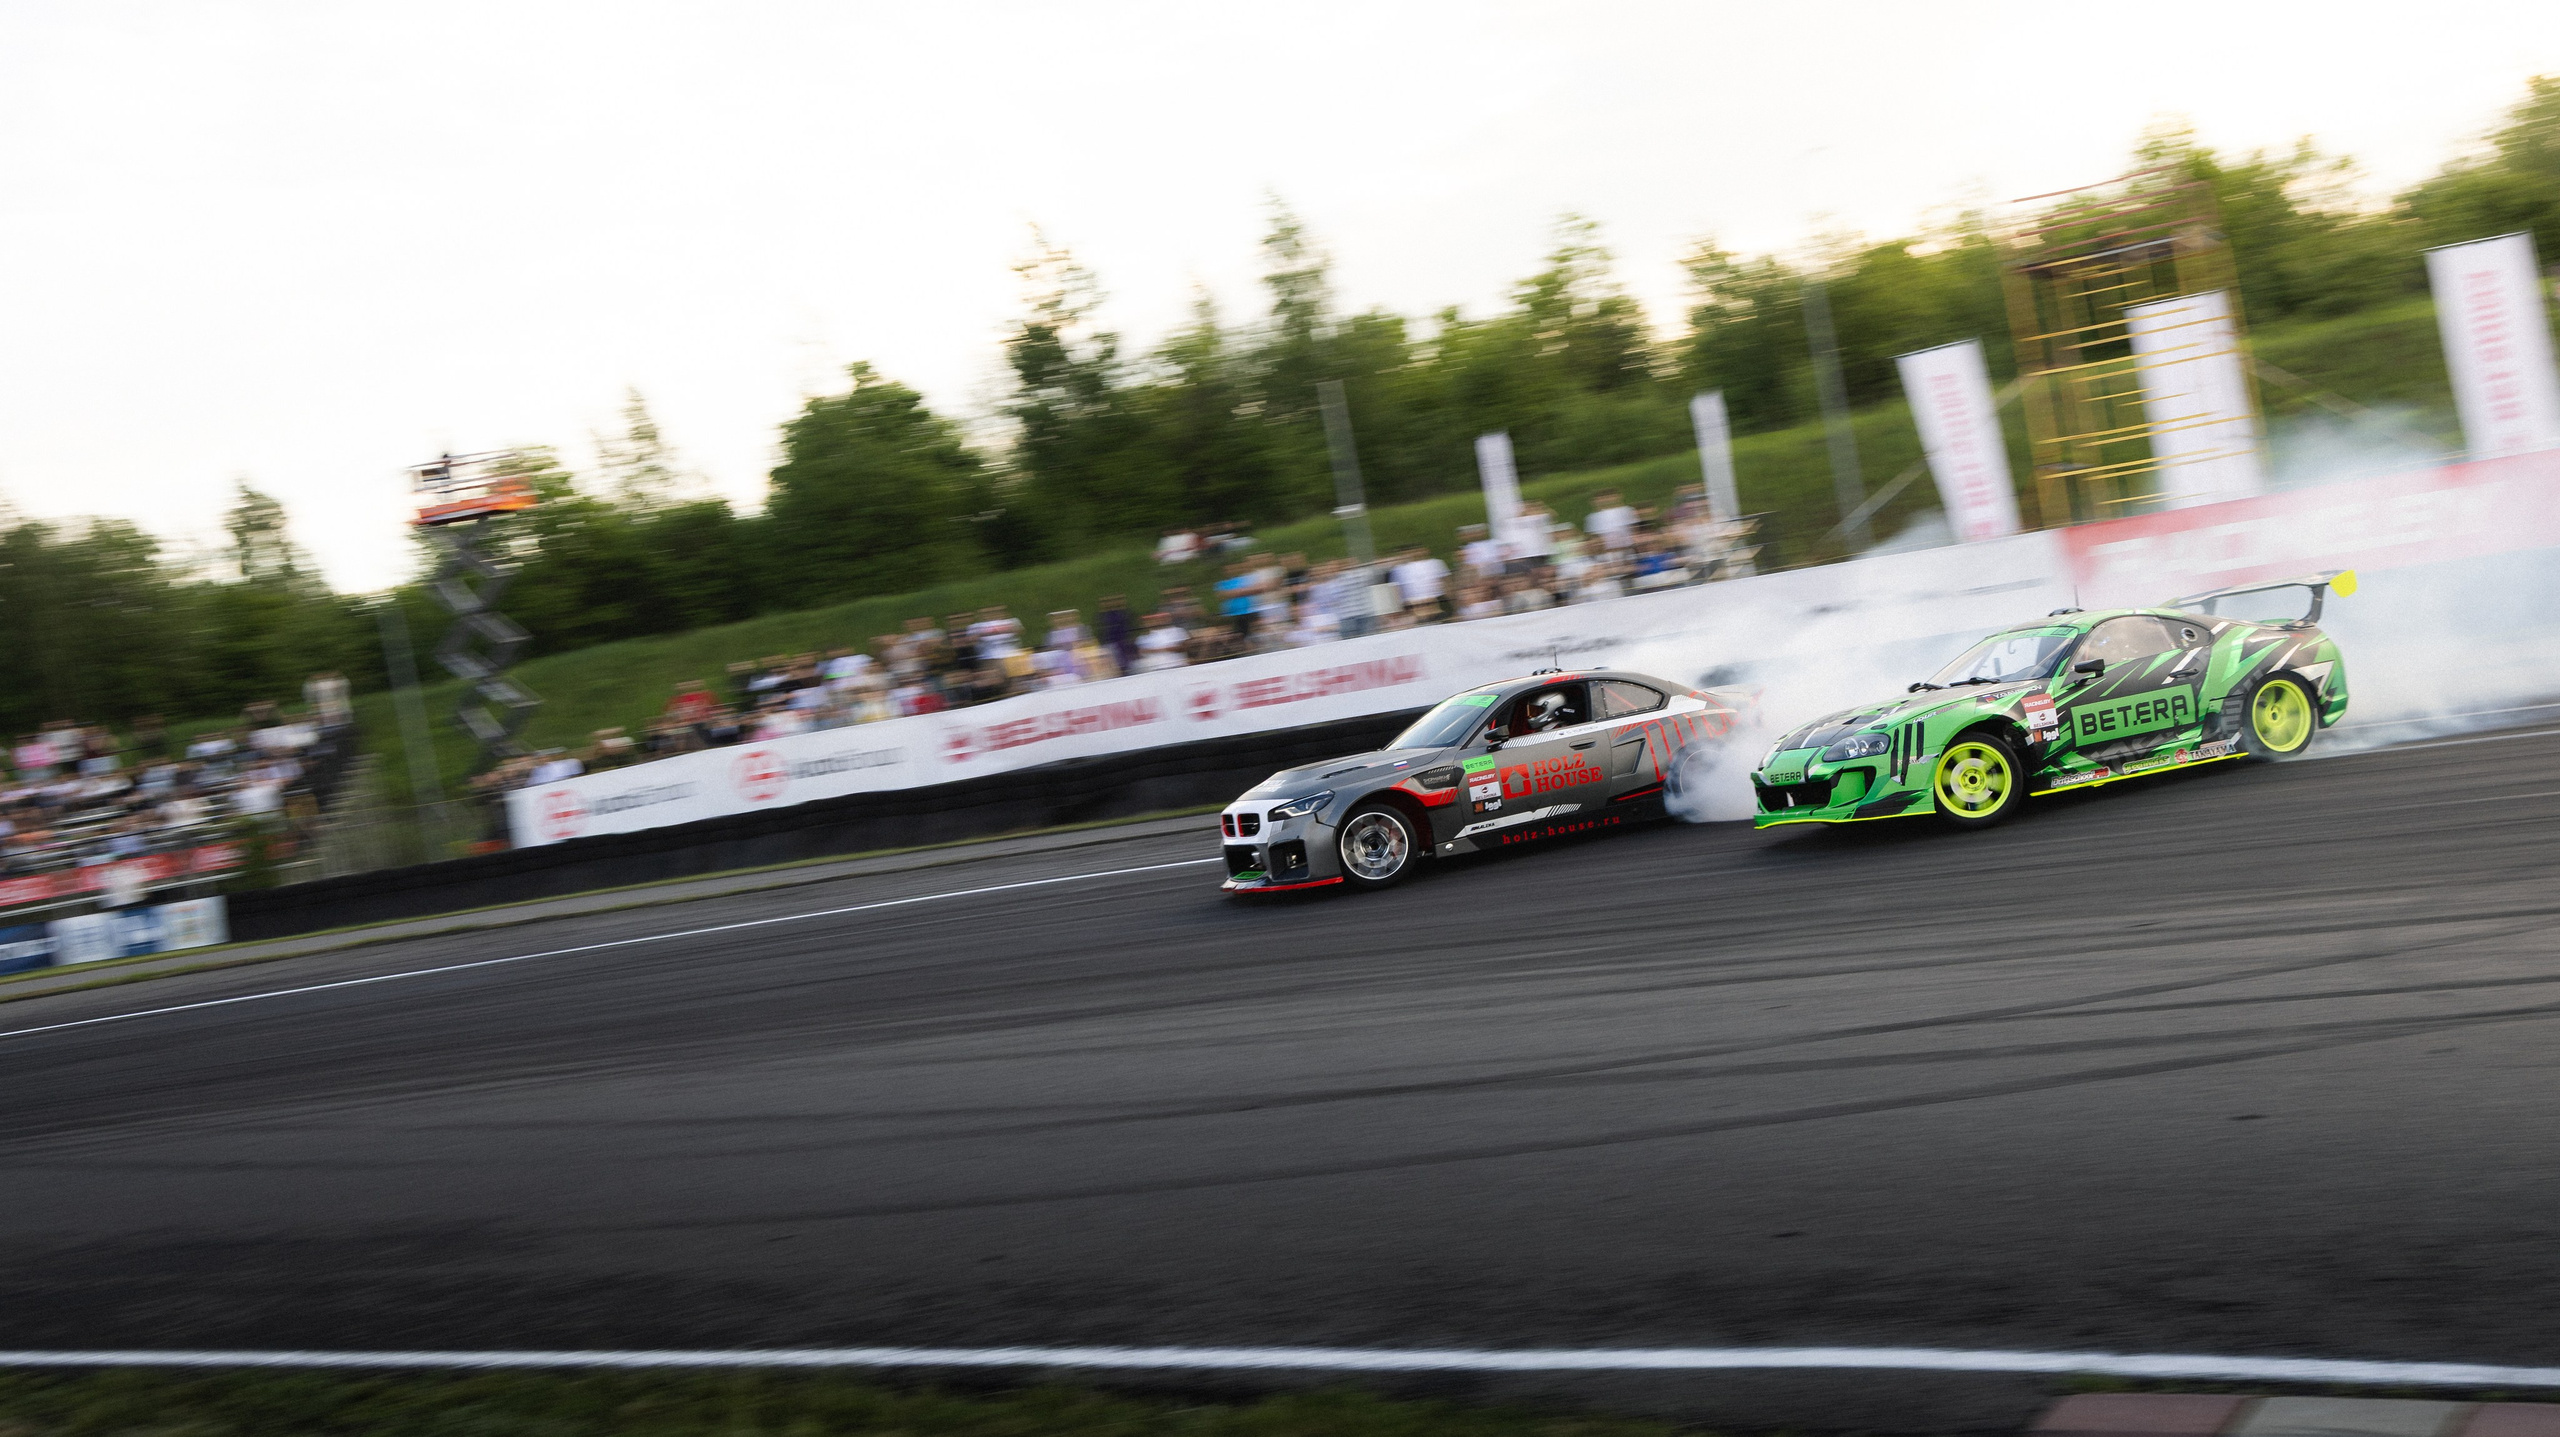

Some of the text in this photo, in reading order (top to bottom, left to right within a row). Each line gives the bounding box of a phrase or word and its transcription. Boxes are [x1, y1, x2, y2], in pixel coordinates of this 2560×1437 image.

[1532, 753, 1586, 776] HOLZ
[1534, 766, 1604, 793] HOUSE
[1502, 816, 1620, 844] holz-house.ru
